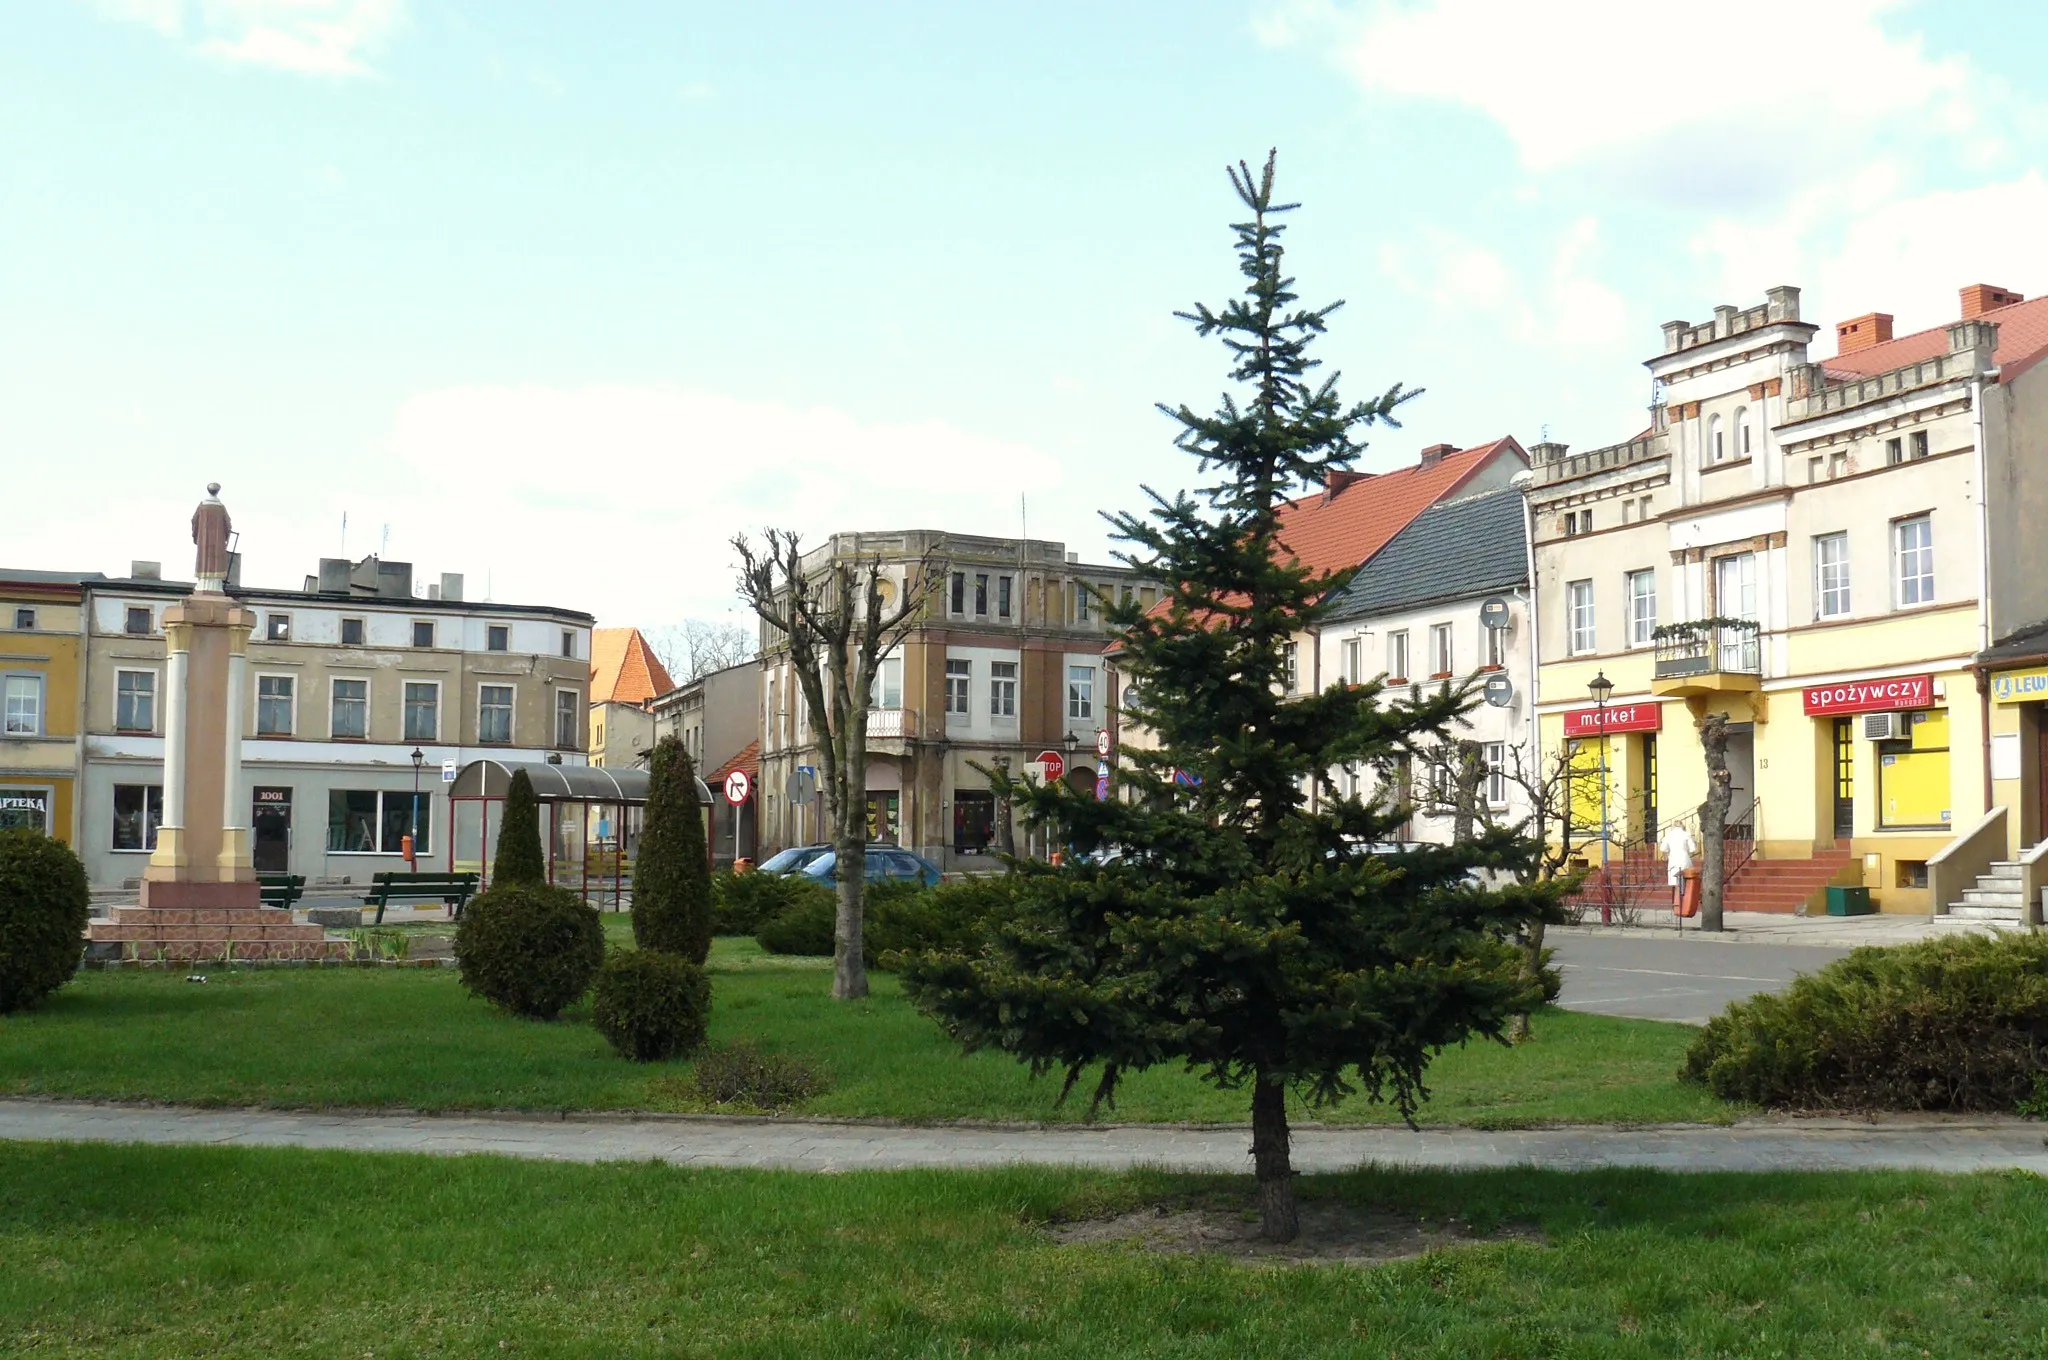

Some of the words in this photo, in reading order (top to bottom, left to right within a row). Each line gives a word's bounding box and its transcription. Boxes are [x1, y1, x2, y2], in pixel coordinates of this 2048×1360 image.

[2015, 675, 2048, 693] LEW
[1810, 680, 1923, 707] spożywczy
[1099, 736, 1107, 749] 40
[1045, 762, 1061, 772] TOP
[1759, 758, 1769, 769] 13
[260, 791, 284, 800] 1001
[0, 797, 46, 812] PTEKA
